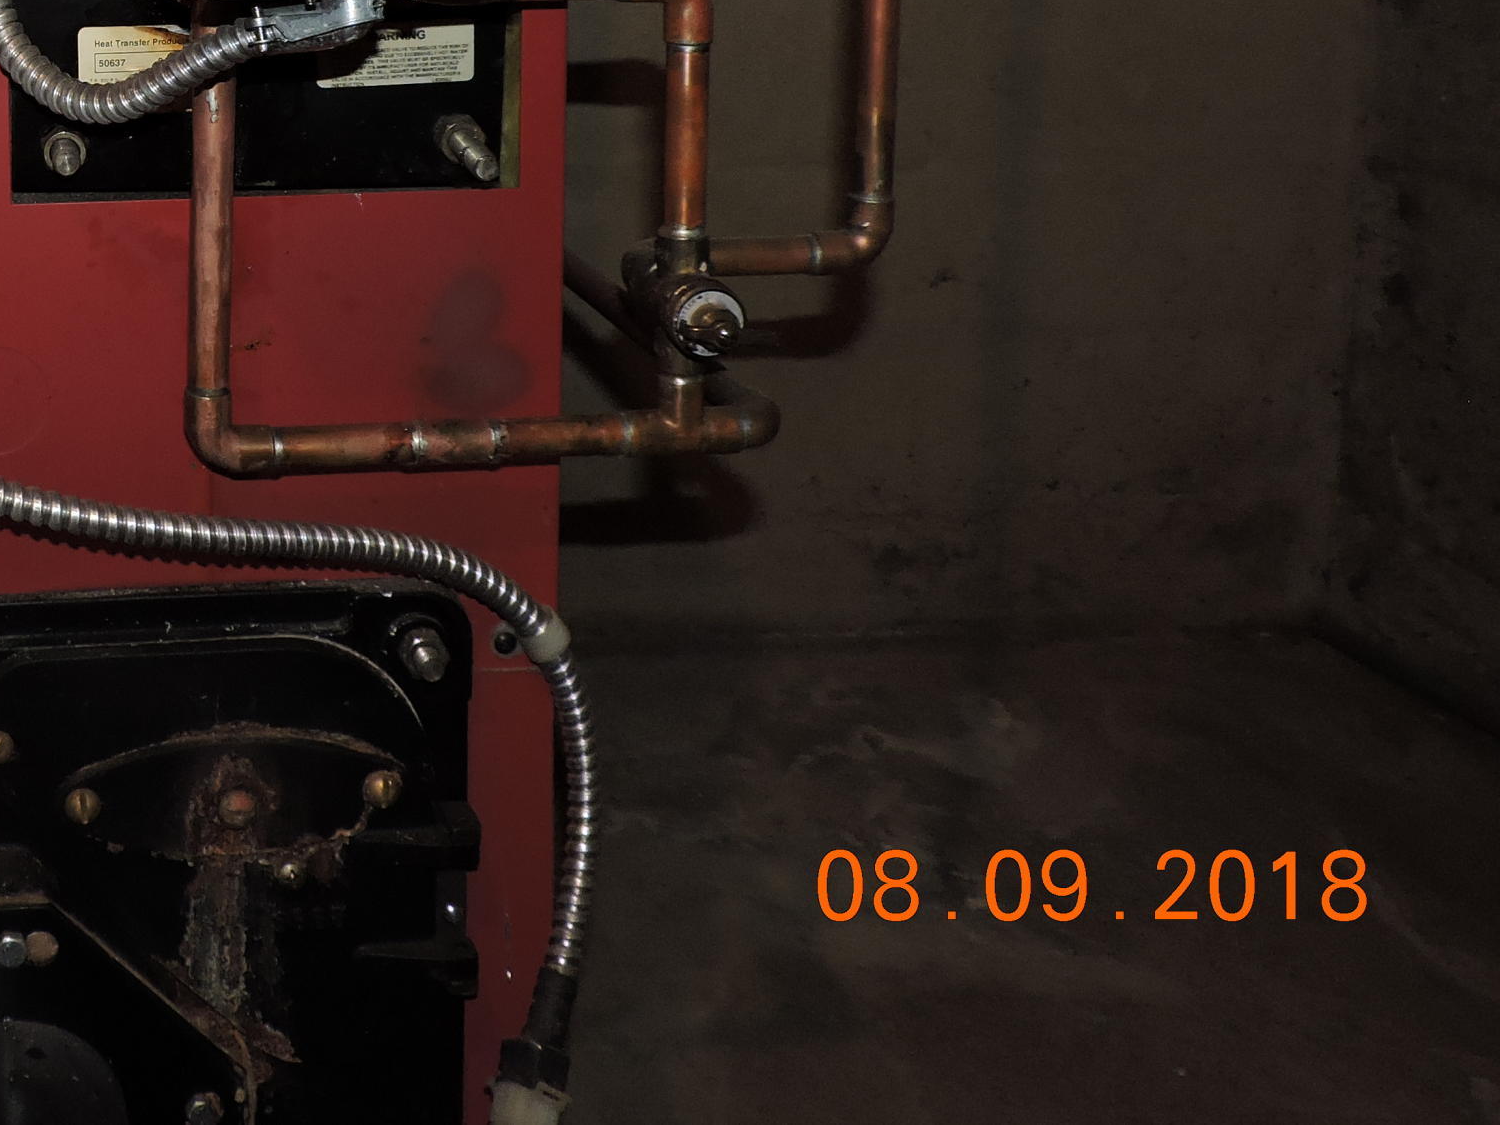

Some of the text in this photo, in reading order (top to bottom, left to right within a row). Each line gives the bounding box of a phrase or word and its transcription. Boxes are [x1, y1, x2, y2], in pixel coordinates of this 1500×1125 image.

[378, 29, 426, 41] ARNING
[94, 37, 181, 48] Heat Transfer Produ
[98, 58, 126, 68] 50637
